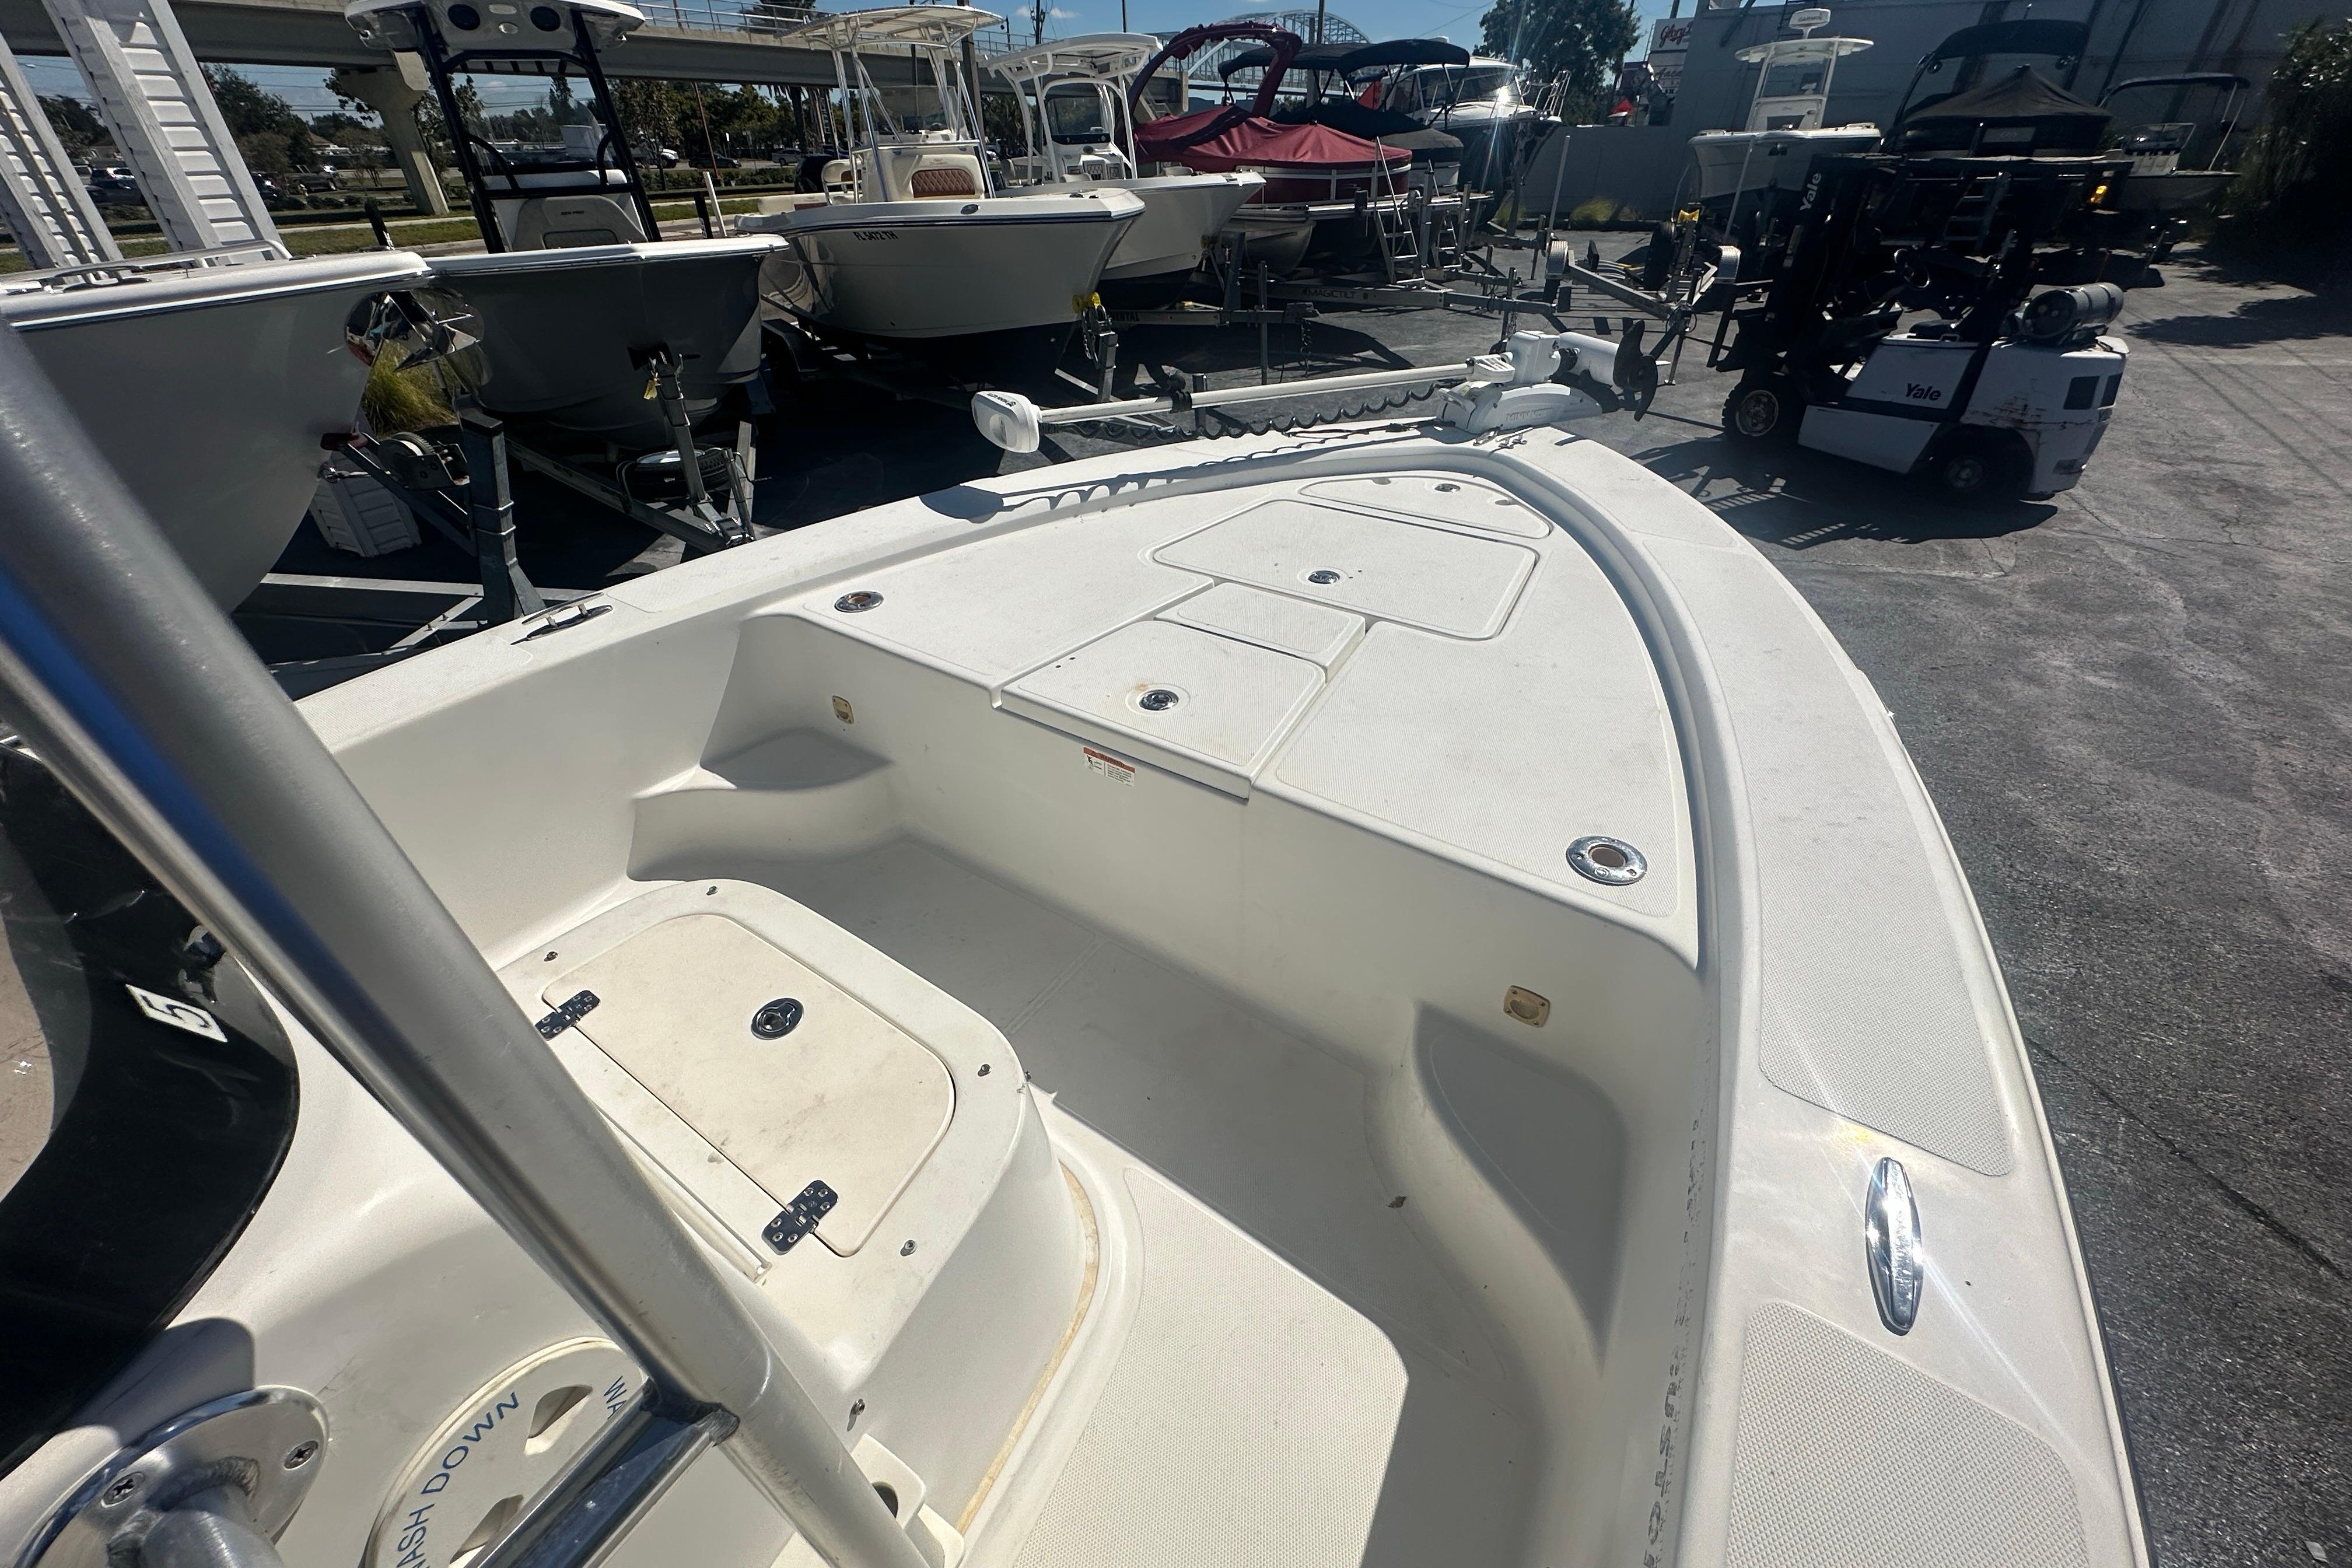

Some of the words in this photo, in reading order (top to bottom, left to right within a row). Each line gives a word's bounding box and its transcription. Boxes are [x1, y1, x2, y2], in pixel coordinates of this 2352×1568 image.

[1799, 173, 1822, 211] Yale
[1905, 383, 1941, 401] Yale
[603, 1375, 628, 1420] WA
[396, 1503, 435, 1568] ASH
[420, 1391, 520, 1495] DOWN
